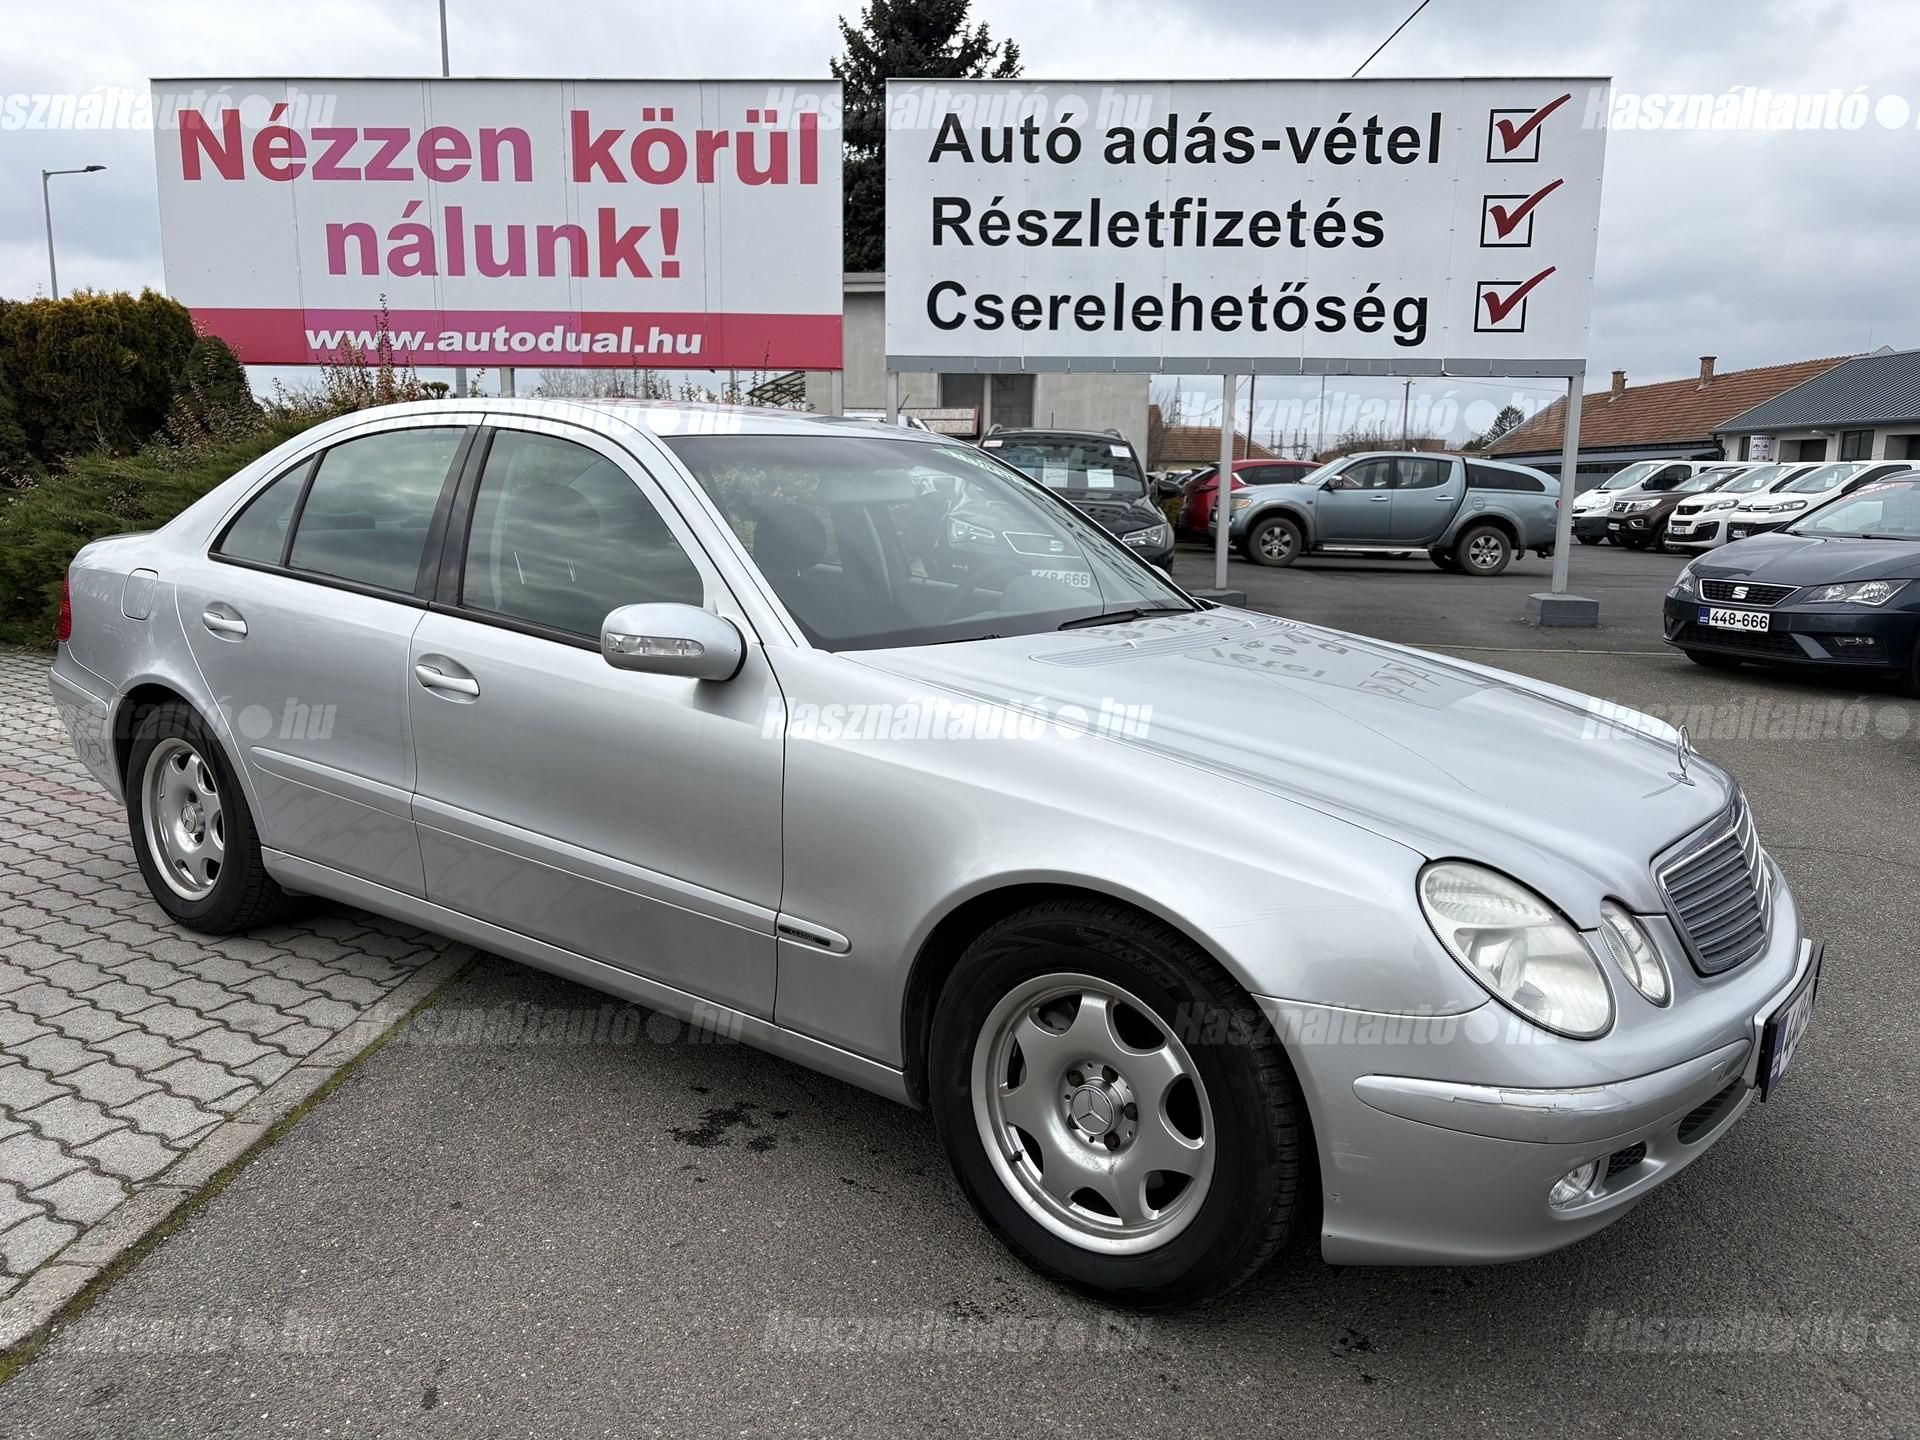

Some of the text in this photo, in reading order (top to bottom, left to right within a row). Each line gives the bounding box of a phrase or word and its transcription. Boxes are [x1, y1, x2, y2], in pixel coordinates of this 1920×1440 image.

[180, 103, 818, 185] Nézzen körül
[928, 111, 1442, 165] Autó adás-vétel
[327, 201, 680, 278] nálunk!
[932, 195, 1384, 249] Részletfizetés
[305, 325, 701, 354] www.autodual.hu
[926, 280, 1428, 347] Cserelehetőség
[1711, 610, 1768, 630] 448-666
